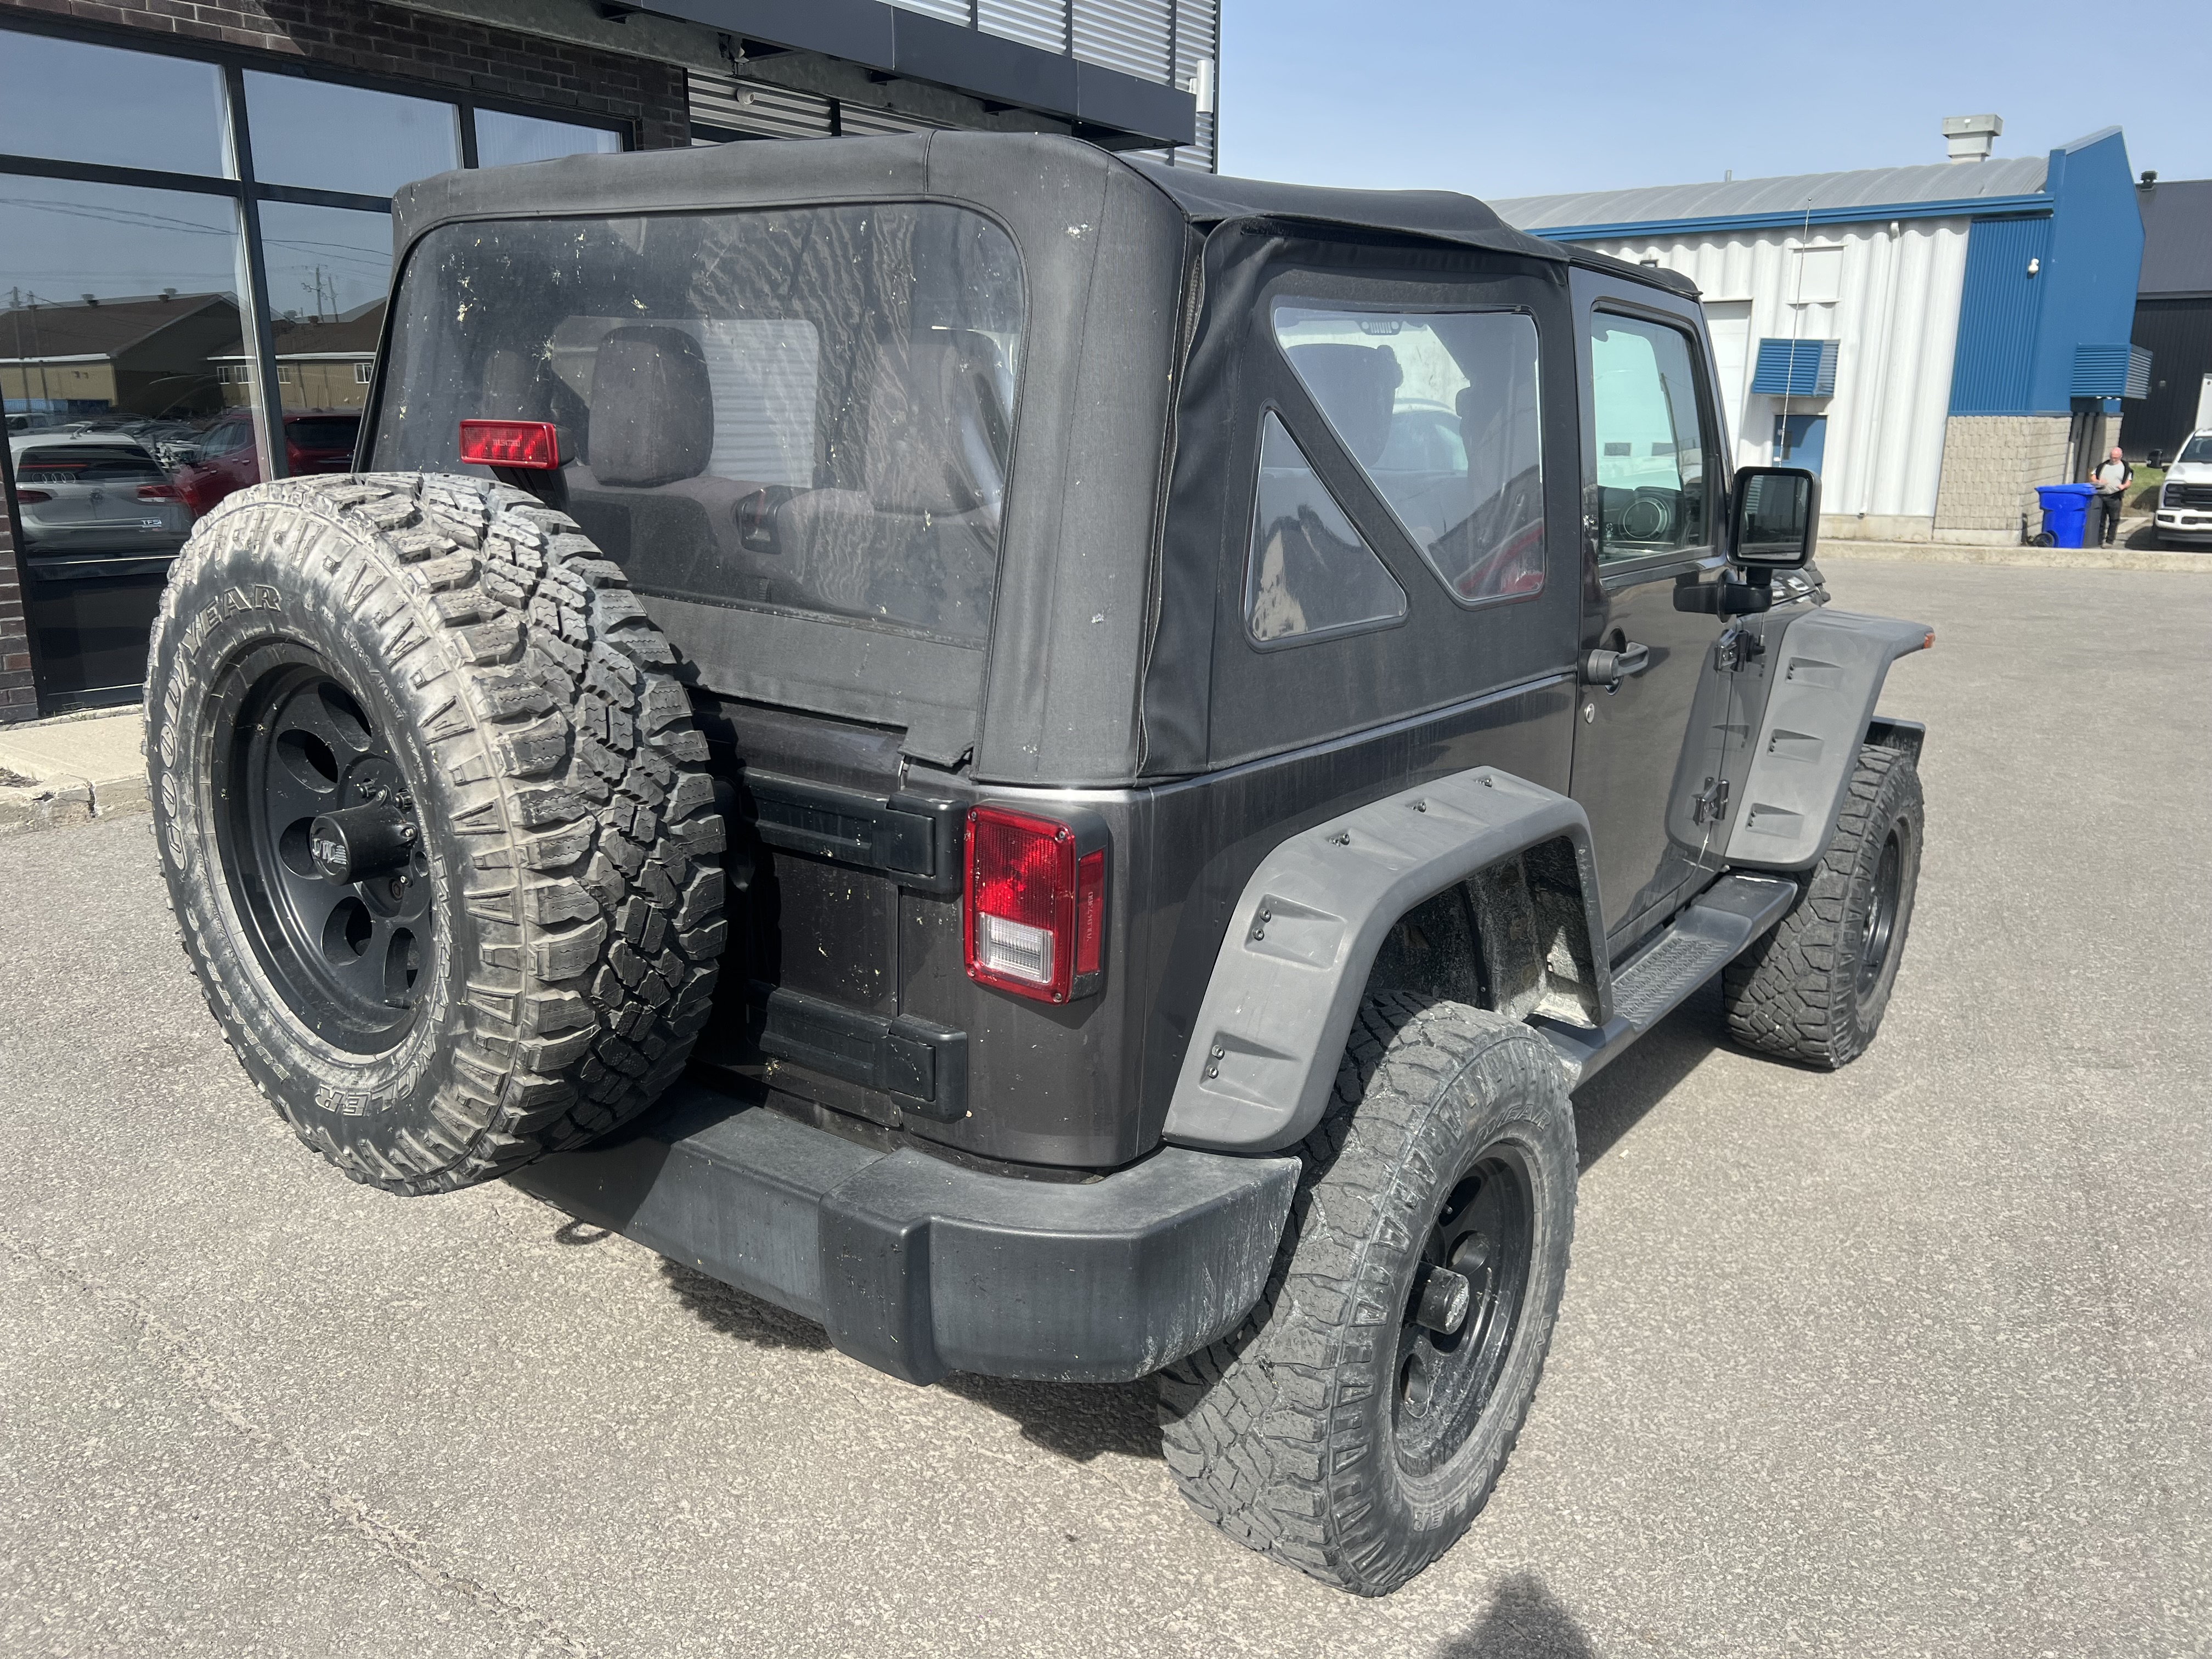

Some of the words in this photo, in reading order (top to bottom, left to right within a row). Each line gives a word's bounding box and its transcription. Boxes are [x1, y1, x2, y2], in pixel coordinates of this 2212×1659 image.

[160, 583, 281, 872] GOODYEAR
[185, 904, 291, 1082] DURATRAC
[315, 854, 453, 1117] WRANGLER
[1413, 1314, 1552, 1532] WRANGLER
